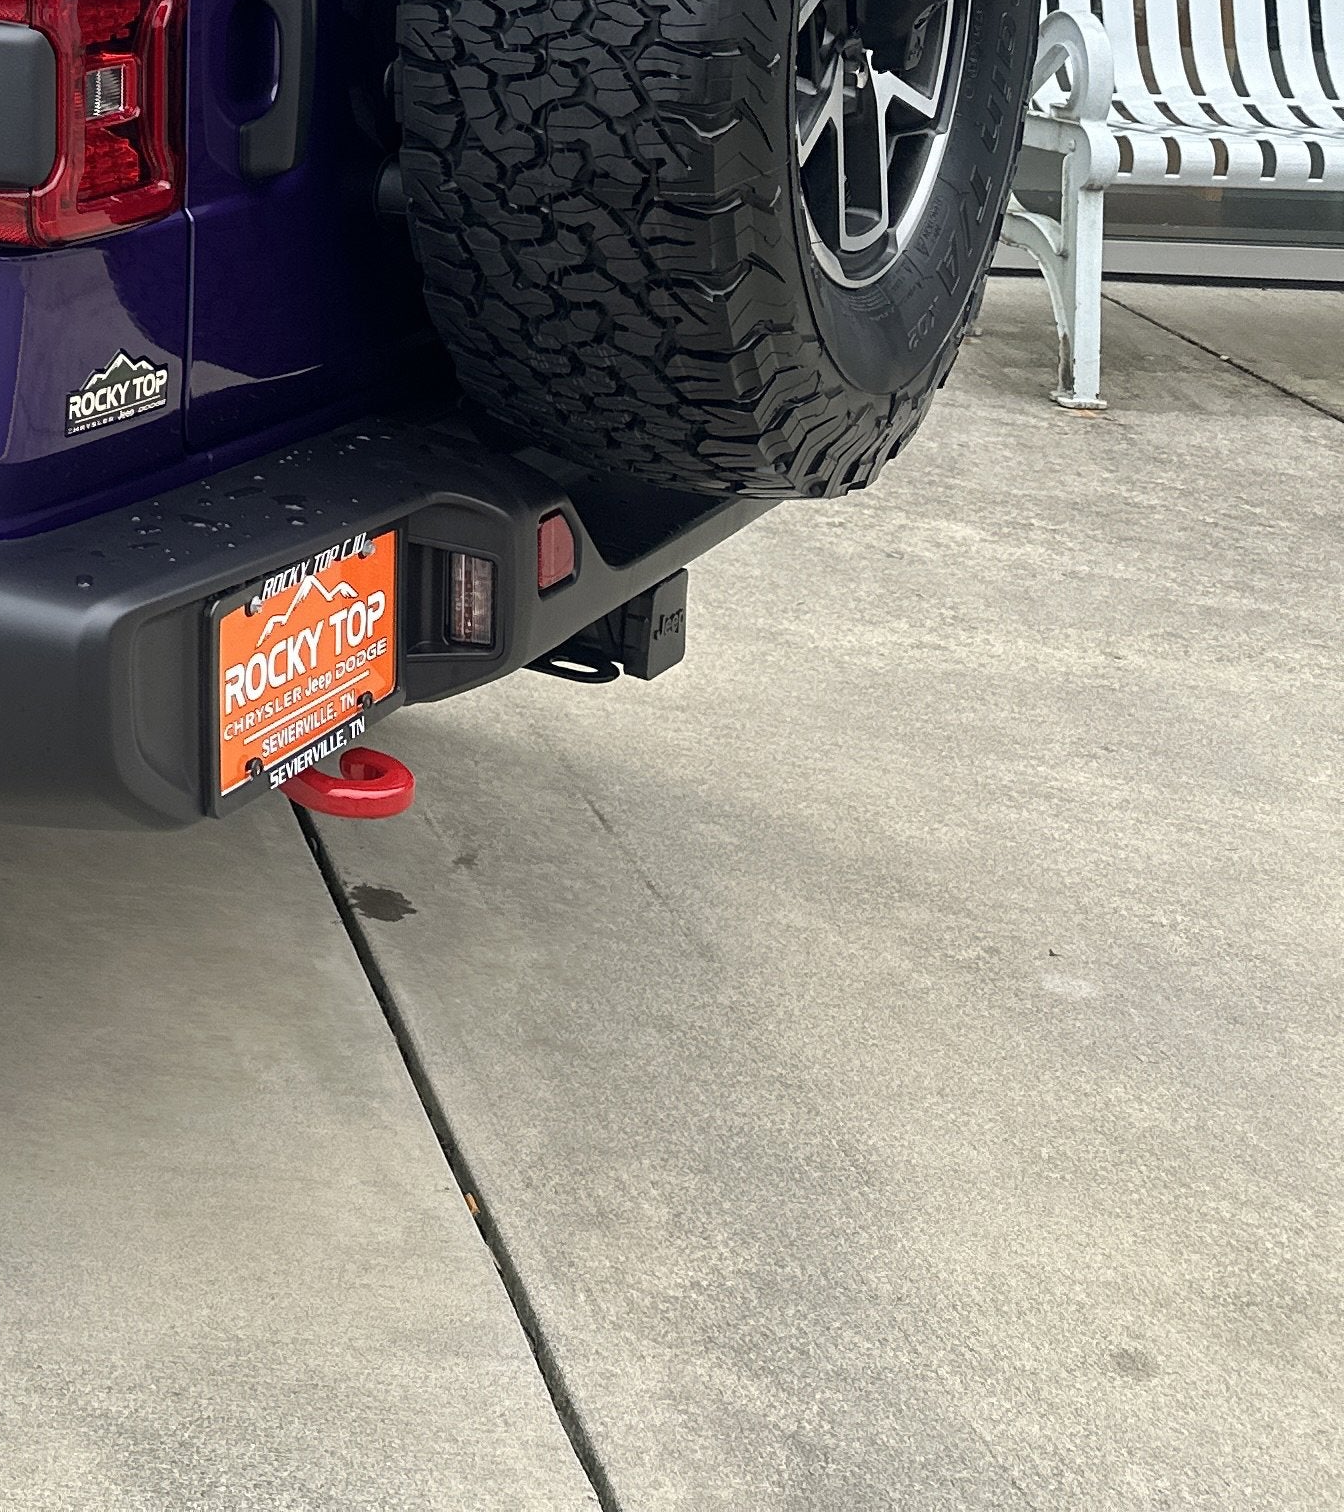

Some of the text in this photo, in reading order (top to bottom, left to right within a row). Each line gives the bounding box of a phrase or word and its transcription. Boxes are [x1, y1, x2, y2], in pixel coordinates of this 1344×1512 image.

[69, 369, 168, 420] ROCKY TOP
[261, 558, 311, 602] ROCKY
[313, 544, 340, 576] TOP
[225, 589, 386, 716] ROCKY TOP
[653, 608, 684, 641] Jeep
[223, 637, 388, 741] CHRYSLER Jeep DODGE
[261, 689, 356, 758] SEVIERVILLE, TN
[269, 715, 366, 790] SEVIERVILLE, TN
